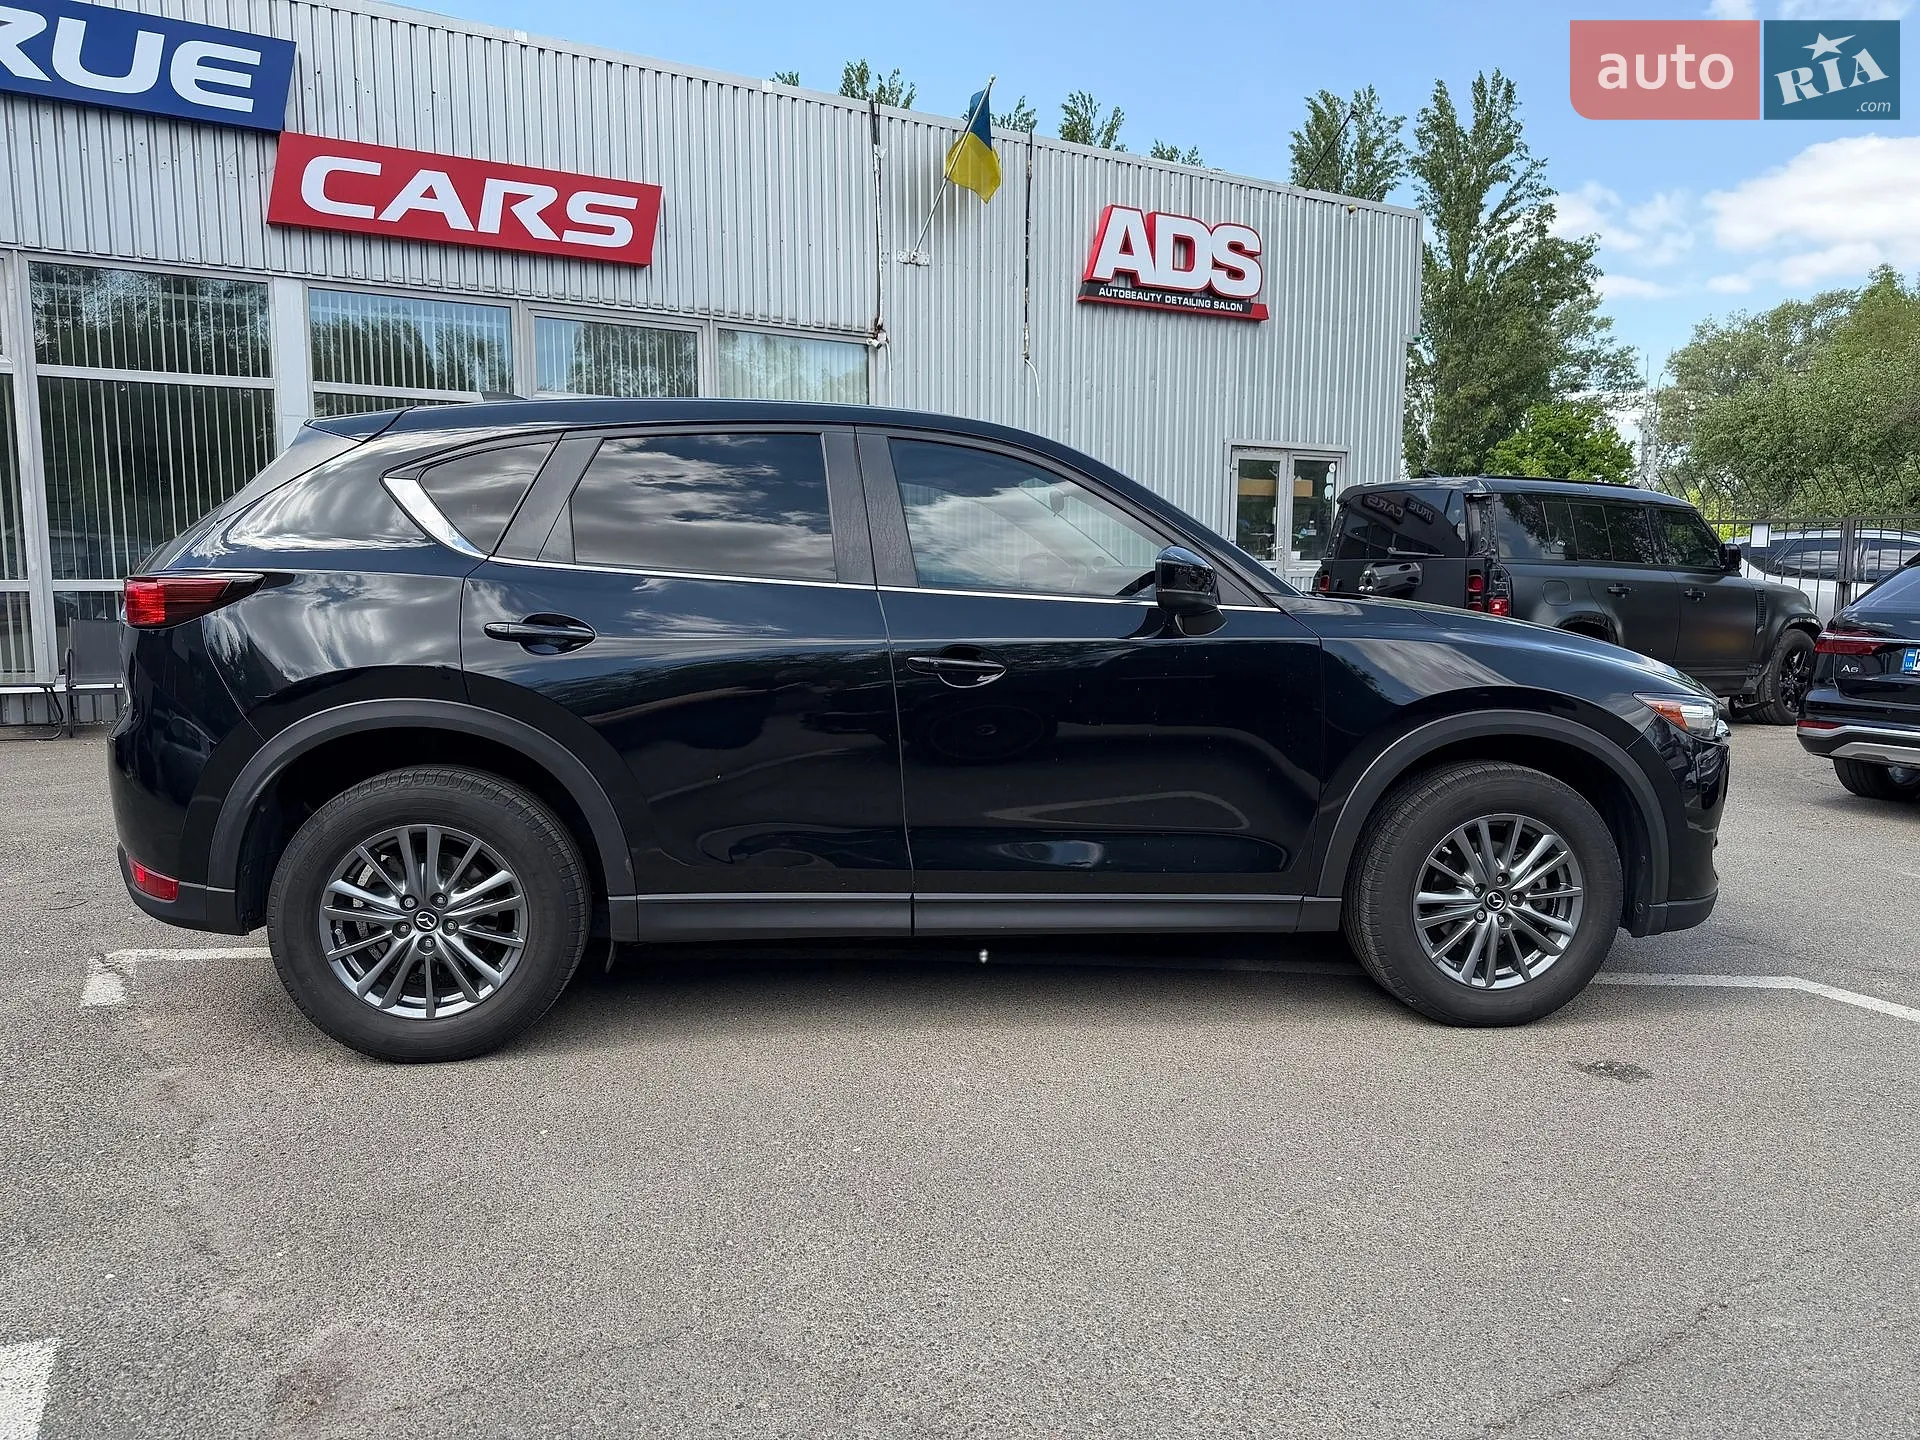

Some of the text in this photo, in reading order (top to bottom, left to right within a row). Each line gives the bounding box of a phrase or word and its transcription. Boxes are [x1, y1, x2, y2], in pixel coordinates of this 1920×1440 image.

[301, 155, 638, 248] CARS
[1088, 204, 1263, 299] ADS
[1098, 287, 1243, 312] AUTOBEAUTY DETAILING SALON
